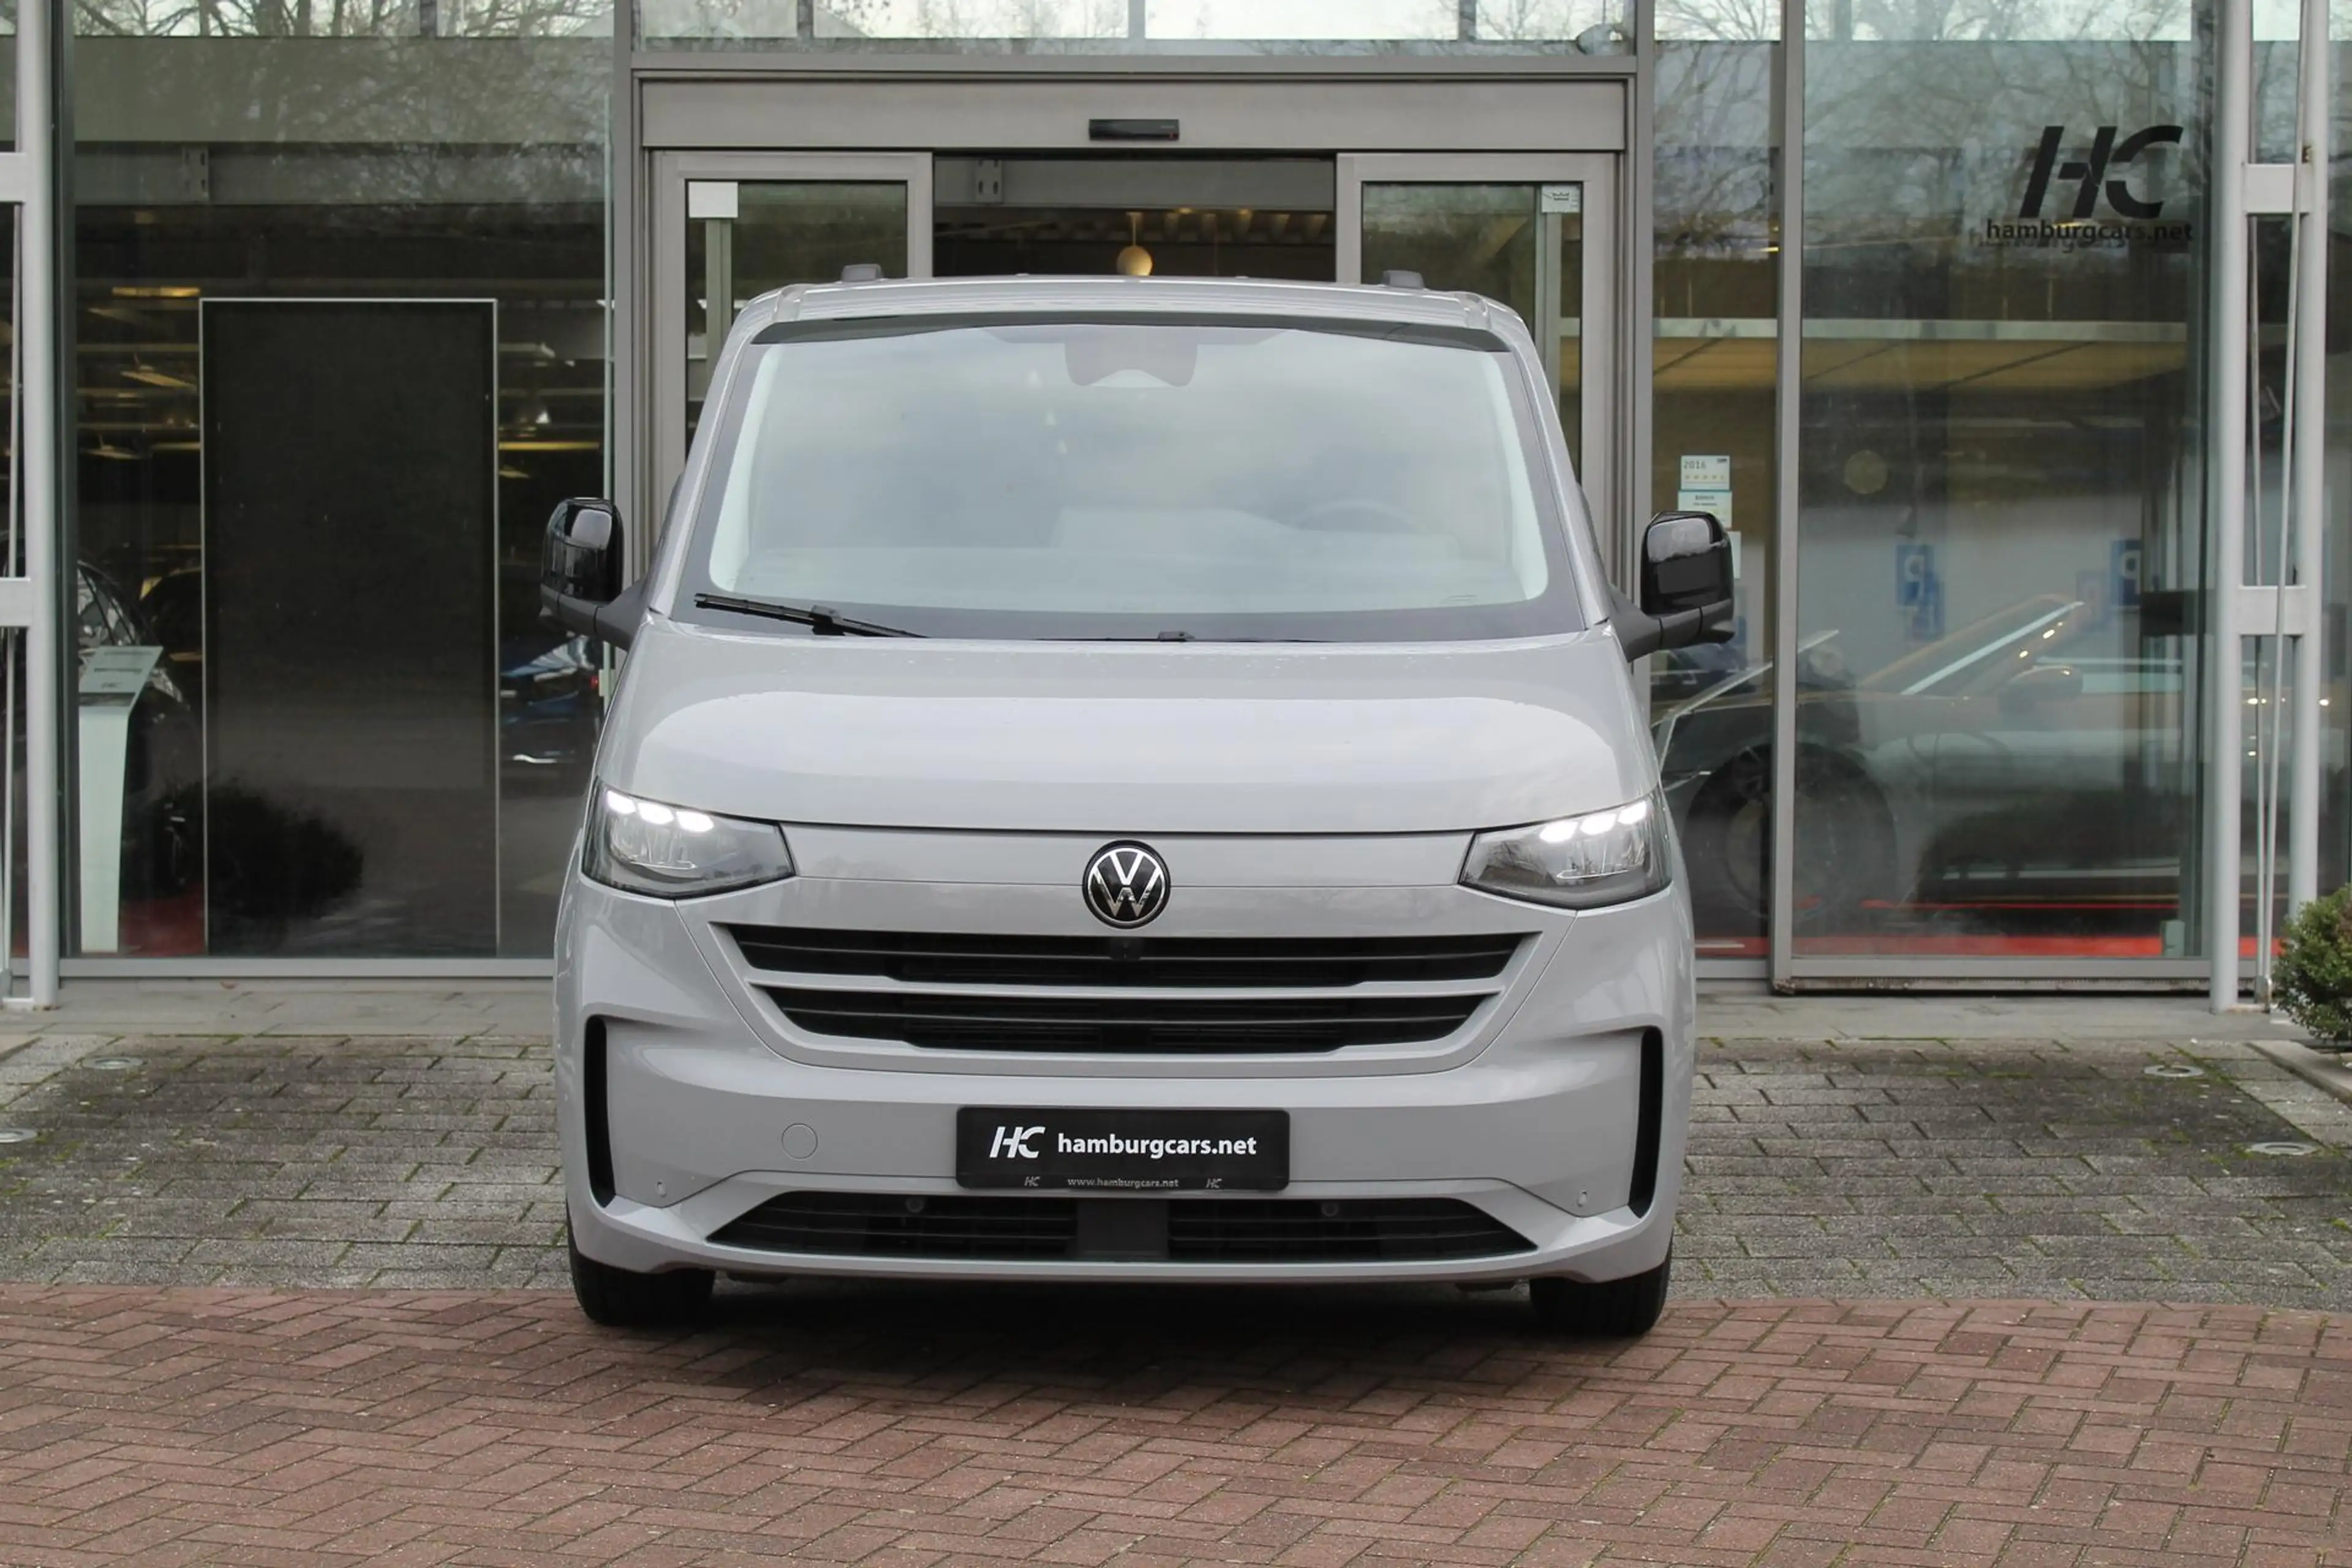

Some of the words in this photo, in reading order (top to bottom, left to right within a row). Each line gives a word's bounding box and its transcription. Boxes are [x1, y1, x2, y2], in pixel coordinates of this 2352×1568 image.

[2019, 126, 2184, 218] HC
[1986, 219, 2193, 244] hamburgcars.net
[989, 1126, 1046, 1158] HC
[1058, 1133, 1257, 1159] hamburgcars.net
[1024, 1176, 1040, 1187] HC
[1067, 1177, 1179, 1189] www.hamburgcars.net
[1206, 1178, 1223, 1188] HC
